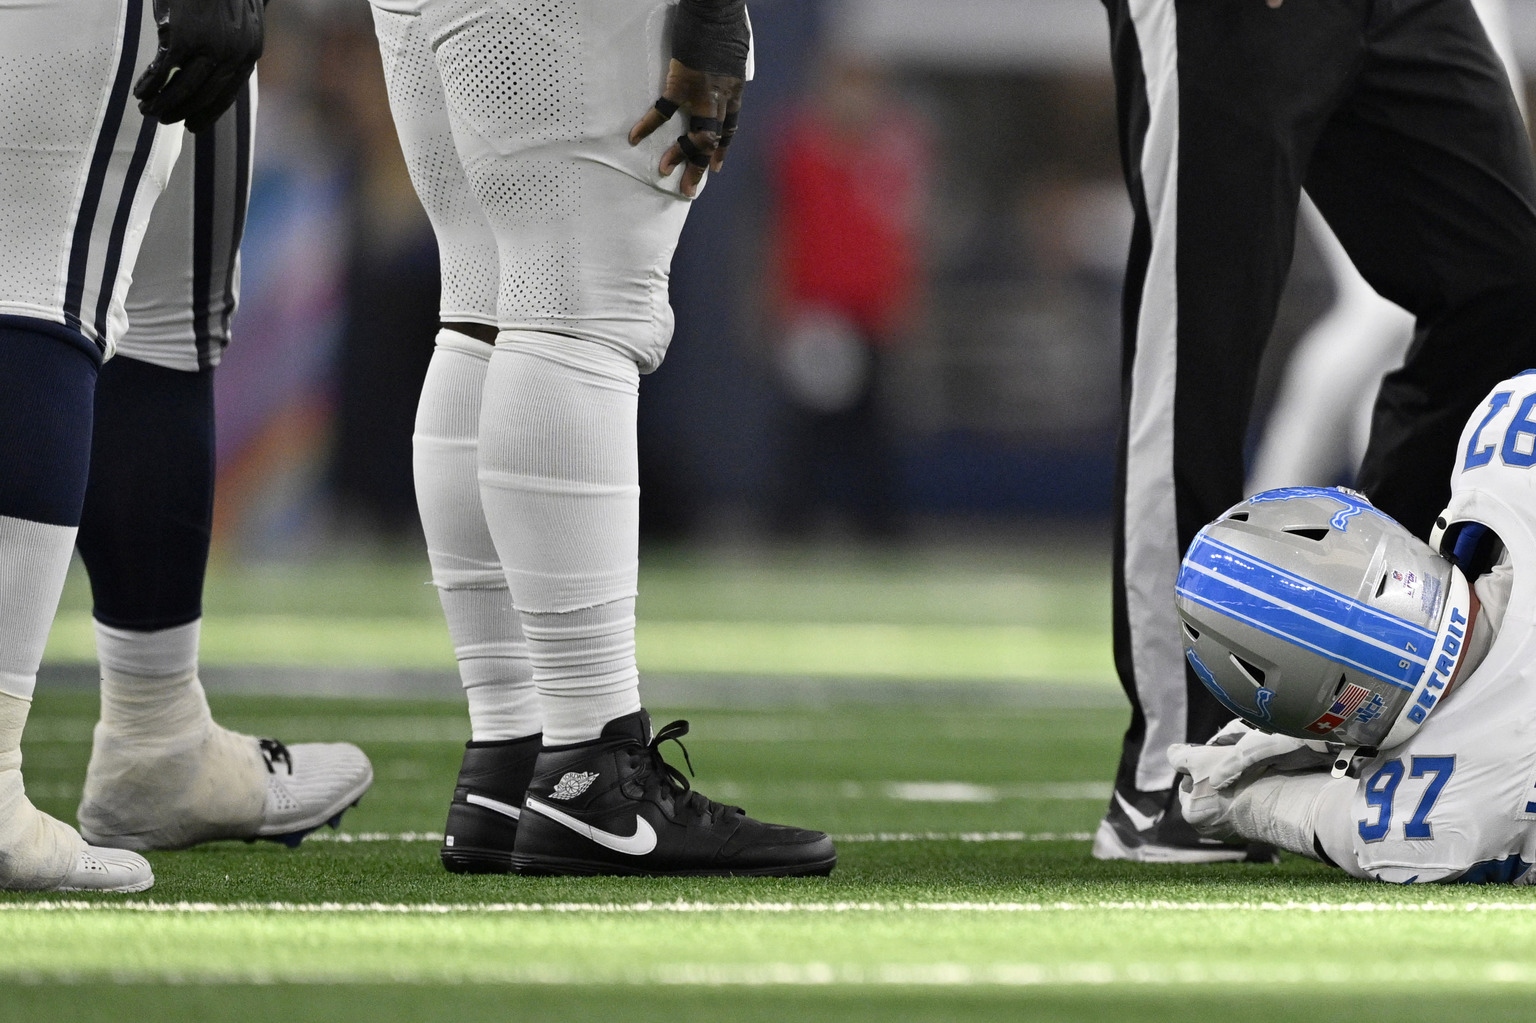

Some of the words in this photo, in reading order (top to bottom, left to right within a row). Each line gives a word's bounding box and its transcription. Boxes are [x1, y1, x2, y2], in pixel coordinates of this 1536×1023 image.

[1354, 693, 1385, 724] WCF
[1407, 607, 1467, 724] DETROIT
[1358, 754, 1456, 844] 97
